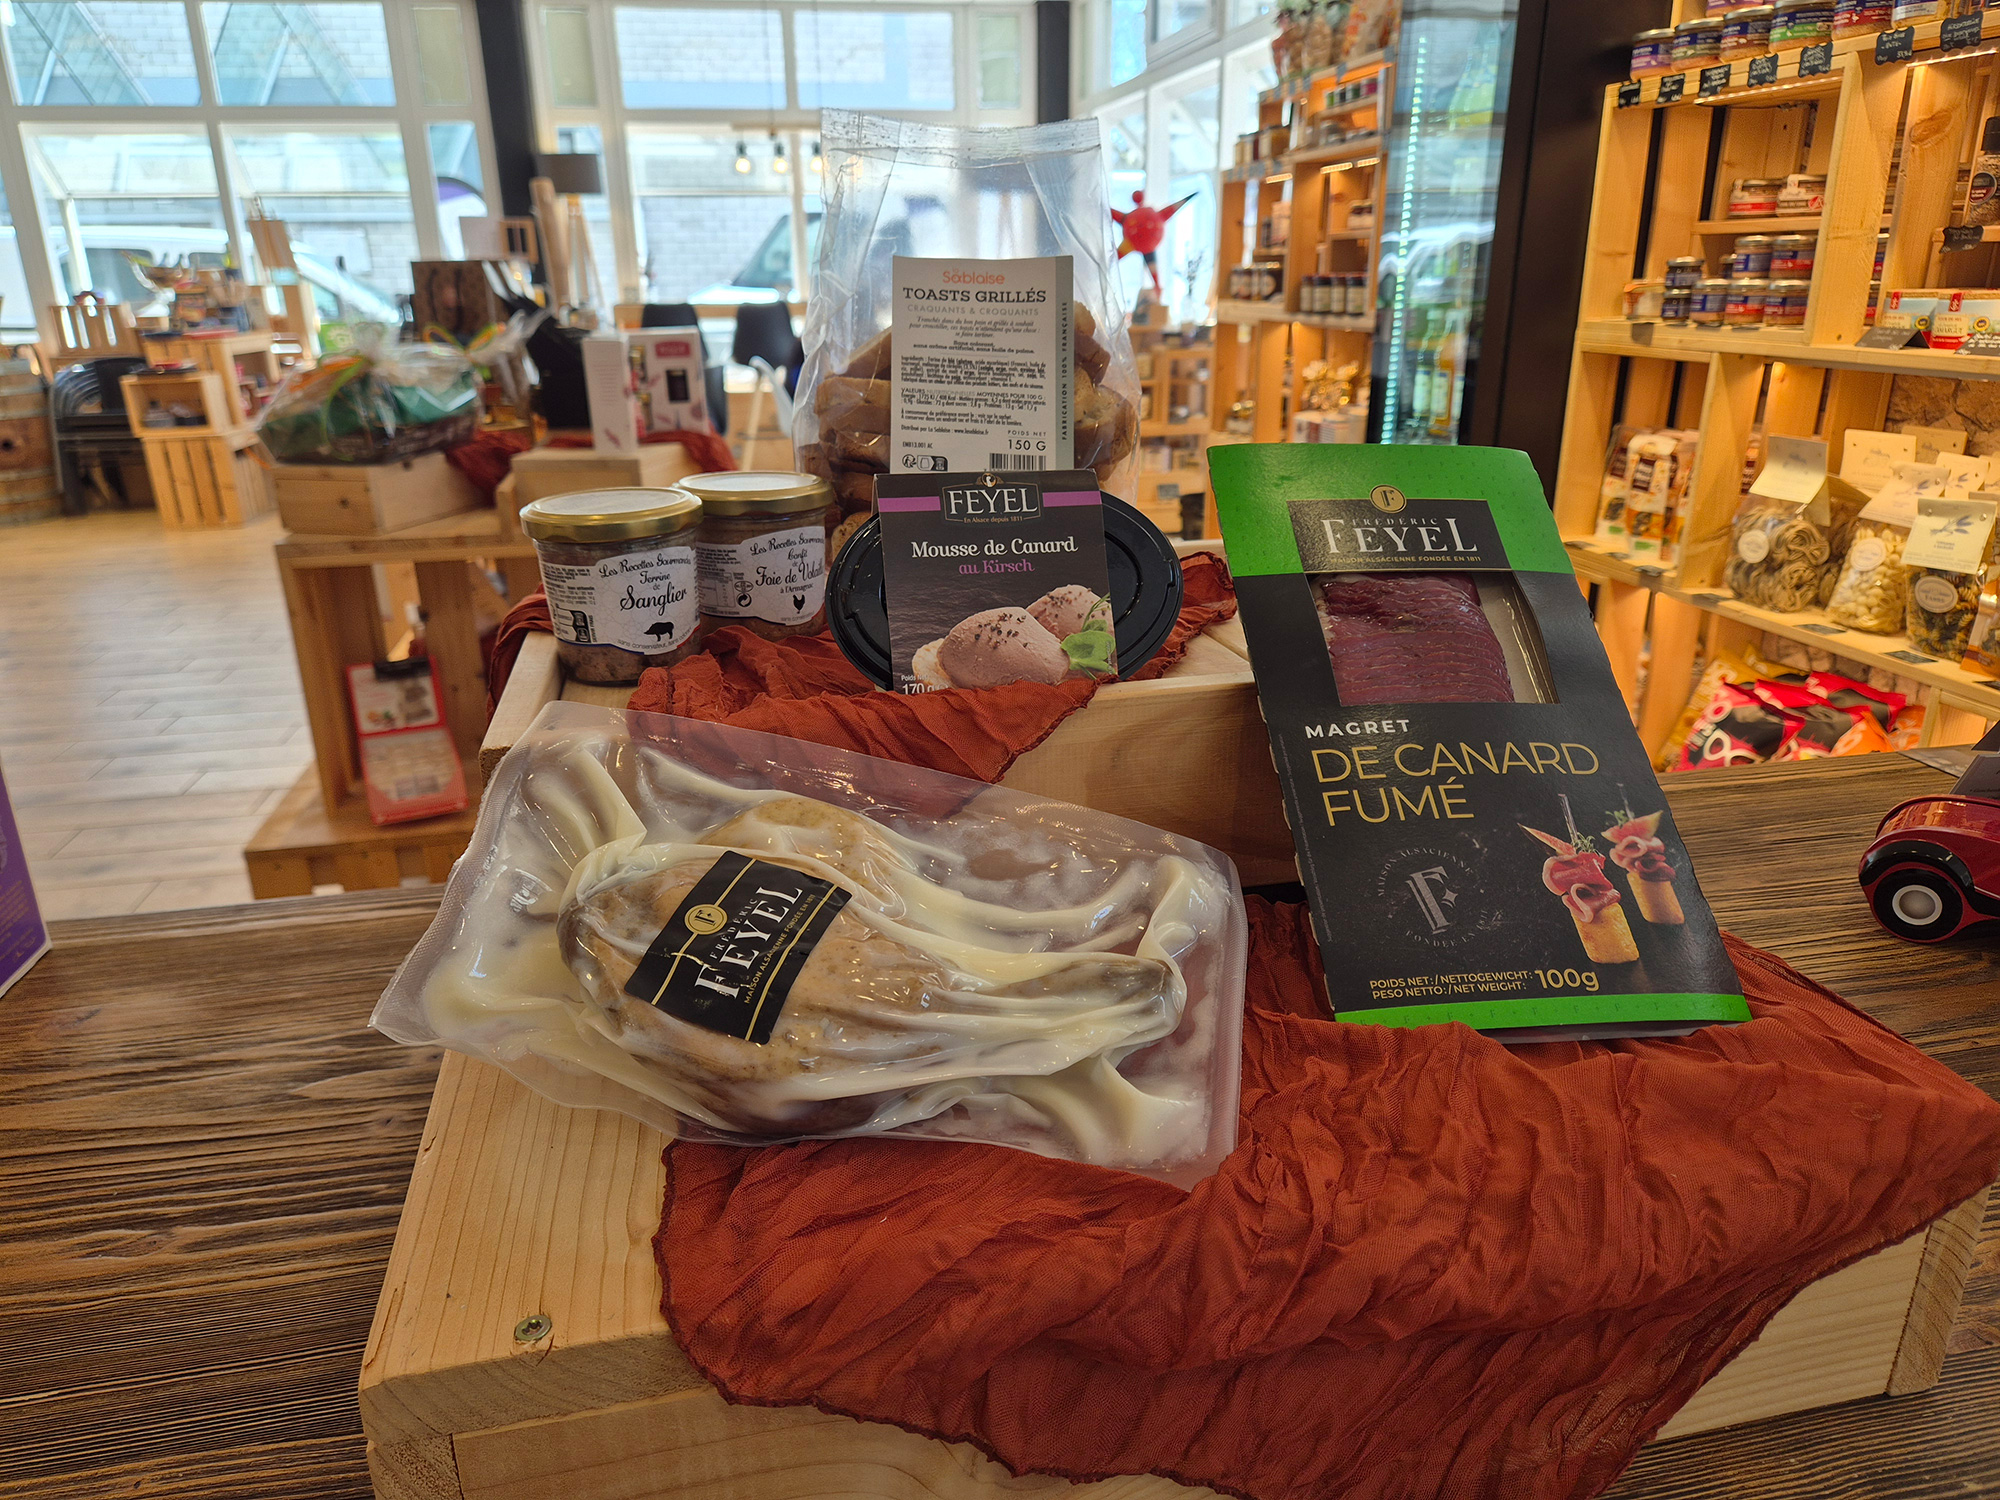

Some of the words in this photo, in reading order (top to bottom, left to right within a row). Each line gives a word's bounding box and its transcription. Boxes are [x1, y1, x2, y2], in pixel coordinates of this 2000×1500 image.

[942, 270, 1006, 284] Sablaise
[902, 288, 970, 302] TOASTS
[974, 287, 1046, 303] GRILLÉS
[907, 304, 966, 314] CRAQUANTS
[980, 308, 1039, 316] CROQUANTS
[1008, 439, 1031, 450] 150
[1036, 440, 1046, 451] G
[947, 488, 1038, 514] FEYEL
[990, 516, 1010, 524] depuis
[1320, 518, 1478, 554] FEYEL
[750, 542, 767, 556] Les
[768, 537, 798, 551] Recettes
[911, 541, 980, 558] Mousse
[984, 539, 1008, 556] de
[1011, 536, 1078, 554] Canard
[598, 564, 618, 578] Les
[620, 558, 654, 574] Recettes
[959, 564, 980, 575] au
[982, 558, 1035, 574] Kirsch
[1418, 554, 1452, 562] FONDÉE
[640, 570, 671, 584] Terrine
[756, 566, 782, 586] Foie
[784, 568, 798, 584] de
[620, 581, 688, 616] Sanglier
[902, 682, 925, 695] 170
[1304, 718, 1410, 740] MAGRET
[1311, 746, 1388, 783] DE
[1394, 742, 1600, 777] CANARD
[1322, 776, 1475, 828] FUMÉ
[694, 886, 804, 1000] FEYEL
[744, 970, 763, 1004] MAISON
[801, 902, 810, 912] EN
[1370, 978, 1406, 990] POIDS
[1534, 968, 1600, 992] 100g
[1372, 988, 1404, 1000] PESO
[1454, 984, 1476, 994] NET
